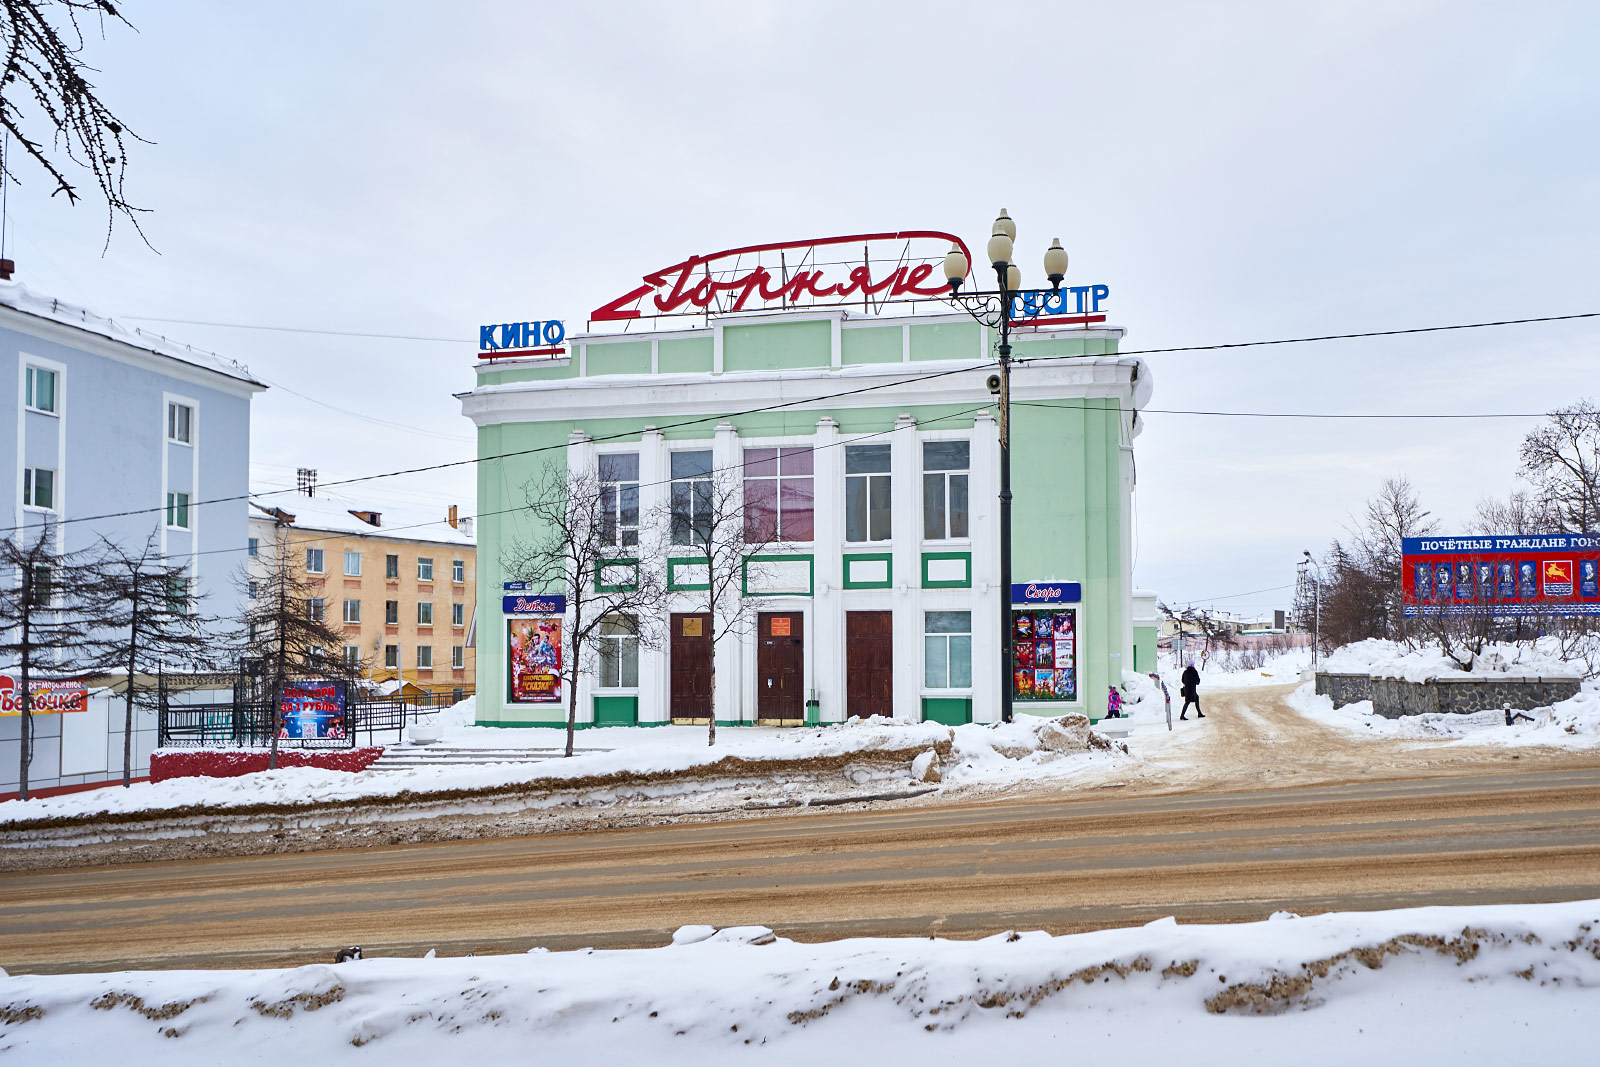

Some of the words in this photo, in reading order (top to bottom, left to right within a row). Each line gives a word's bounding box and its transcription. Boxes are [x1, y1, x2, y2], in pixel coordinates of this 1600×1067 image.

[480, 320, 565, 350] КИНО
[1420, 538, 1492, 551] ПОЧЁТНЫЕ
[1495, 537, 1567, 549] ГРАЖДАНЕ
[1025, 584, 1062, 602] Скоро
[513, 597, 556, 612] Детям
[280, 701, 294, 713] ЗА
[295, 701, 301, 712] 1
[302, 701, 338, 713] РУБЛЬ!
